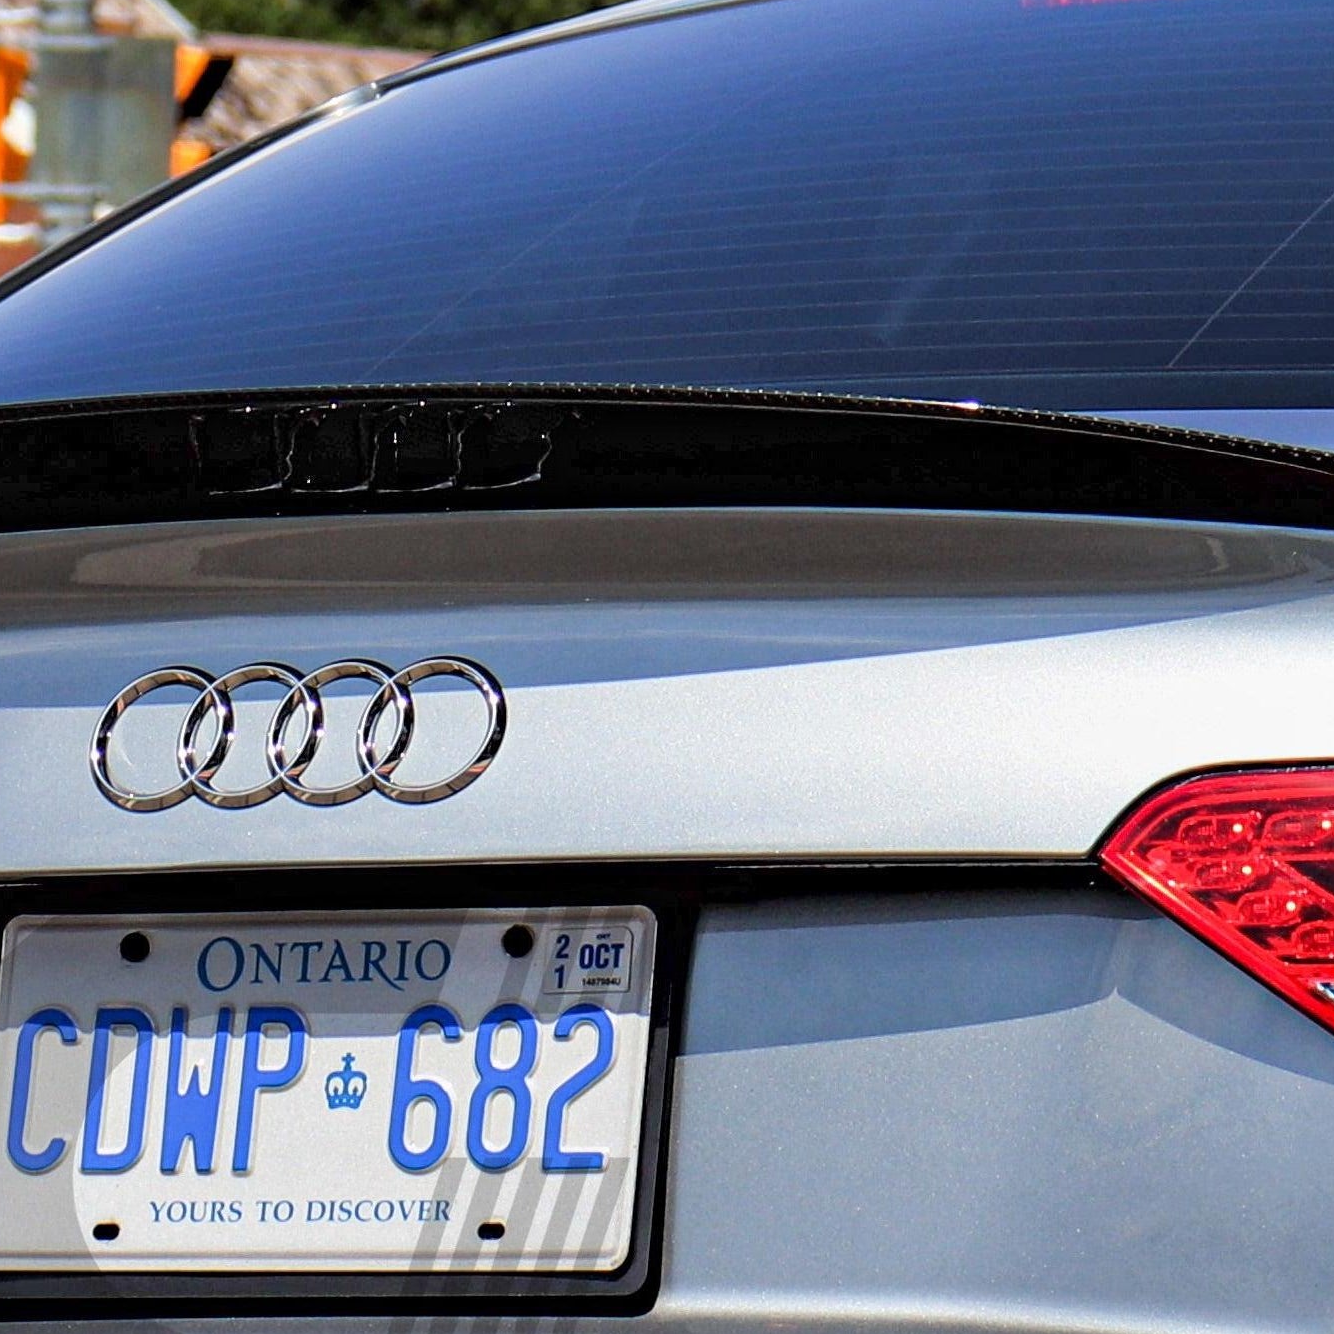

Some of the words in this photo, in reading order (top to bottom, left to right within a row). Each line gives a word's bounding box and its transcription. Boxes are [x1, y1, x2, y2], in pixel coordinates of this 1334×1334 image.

[197, 936, 452, 992] ONTARIO
[579, 943, 625, 970] OCT
[6, 1005, 308, 1174] CDWP
[387, 1003, 616, 1174] 682
[150, 1200, 243, 1223] YOURS
[256, 1200, 295, 1223] TO
[305, 1199, 452, 1223] DISCOVER
